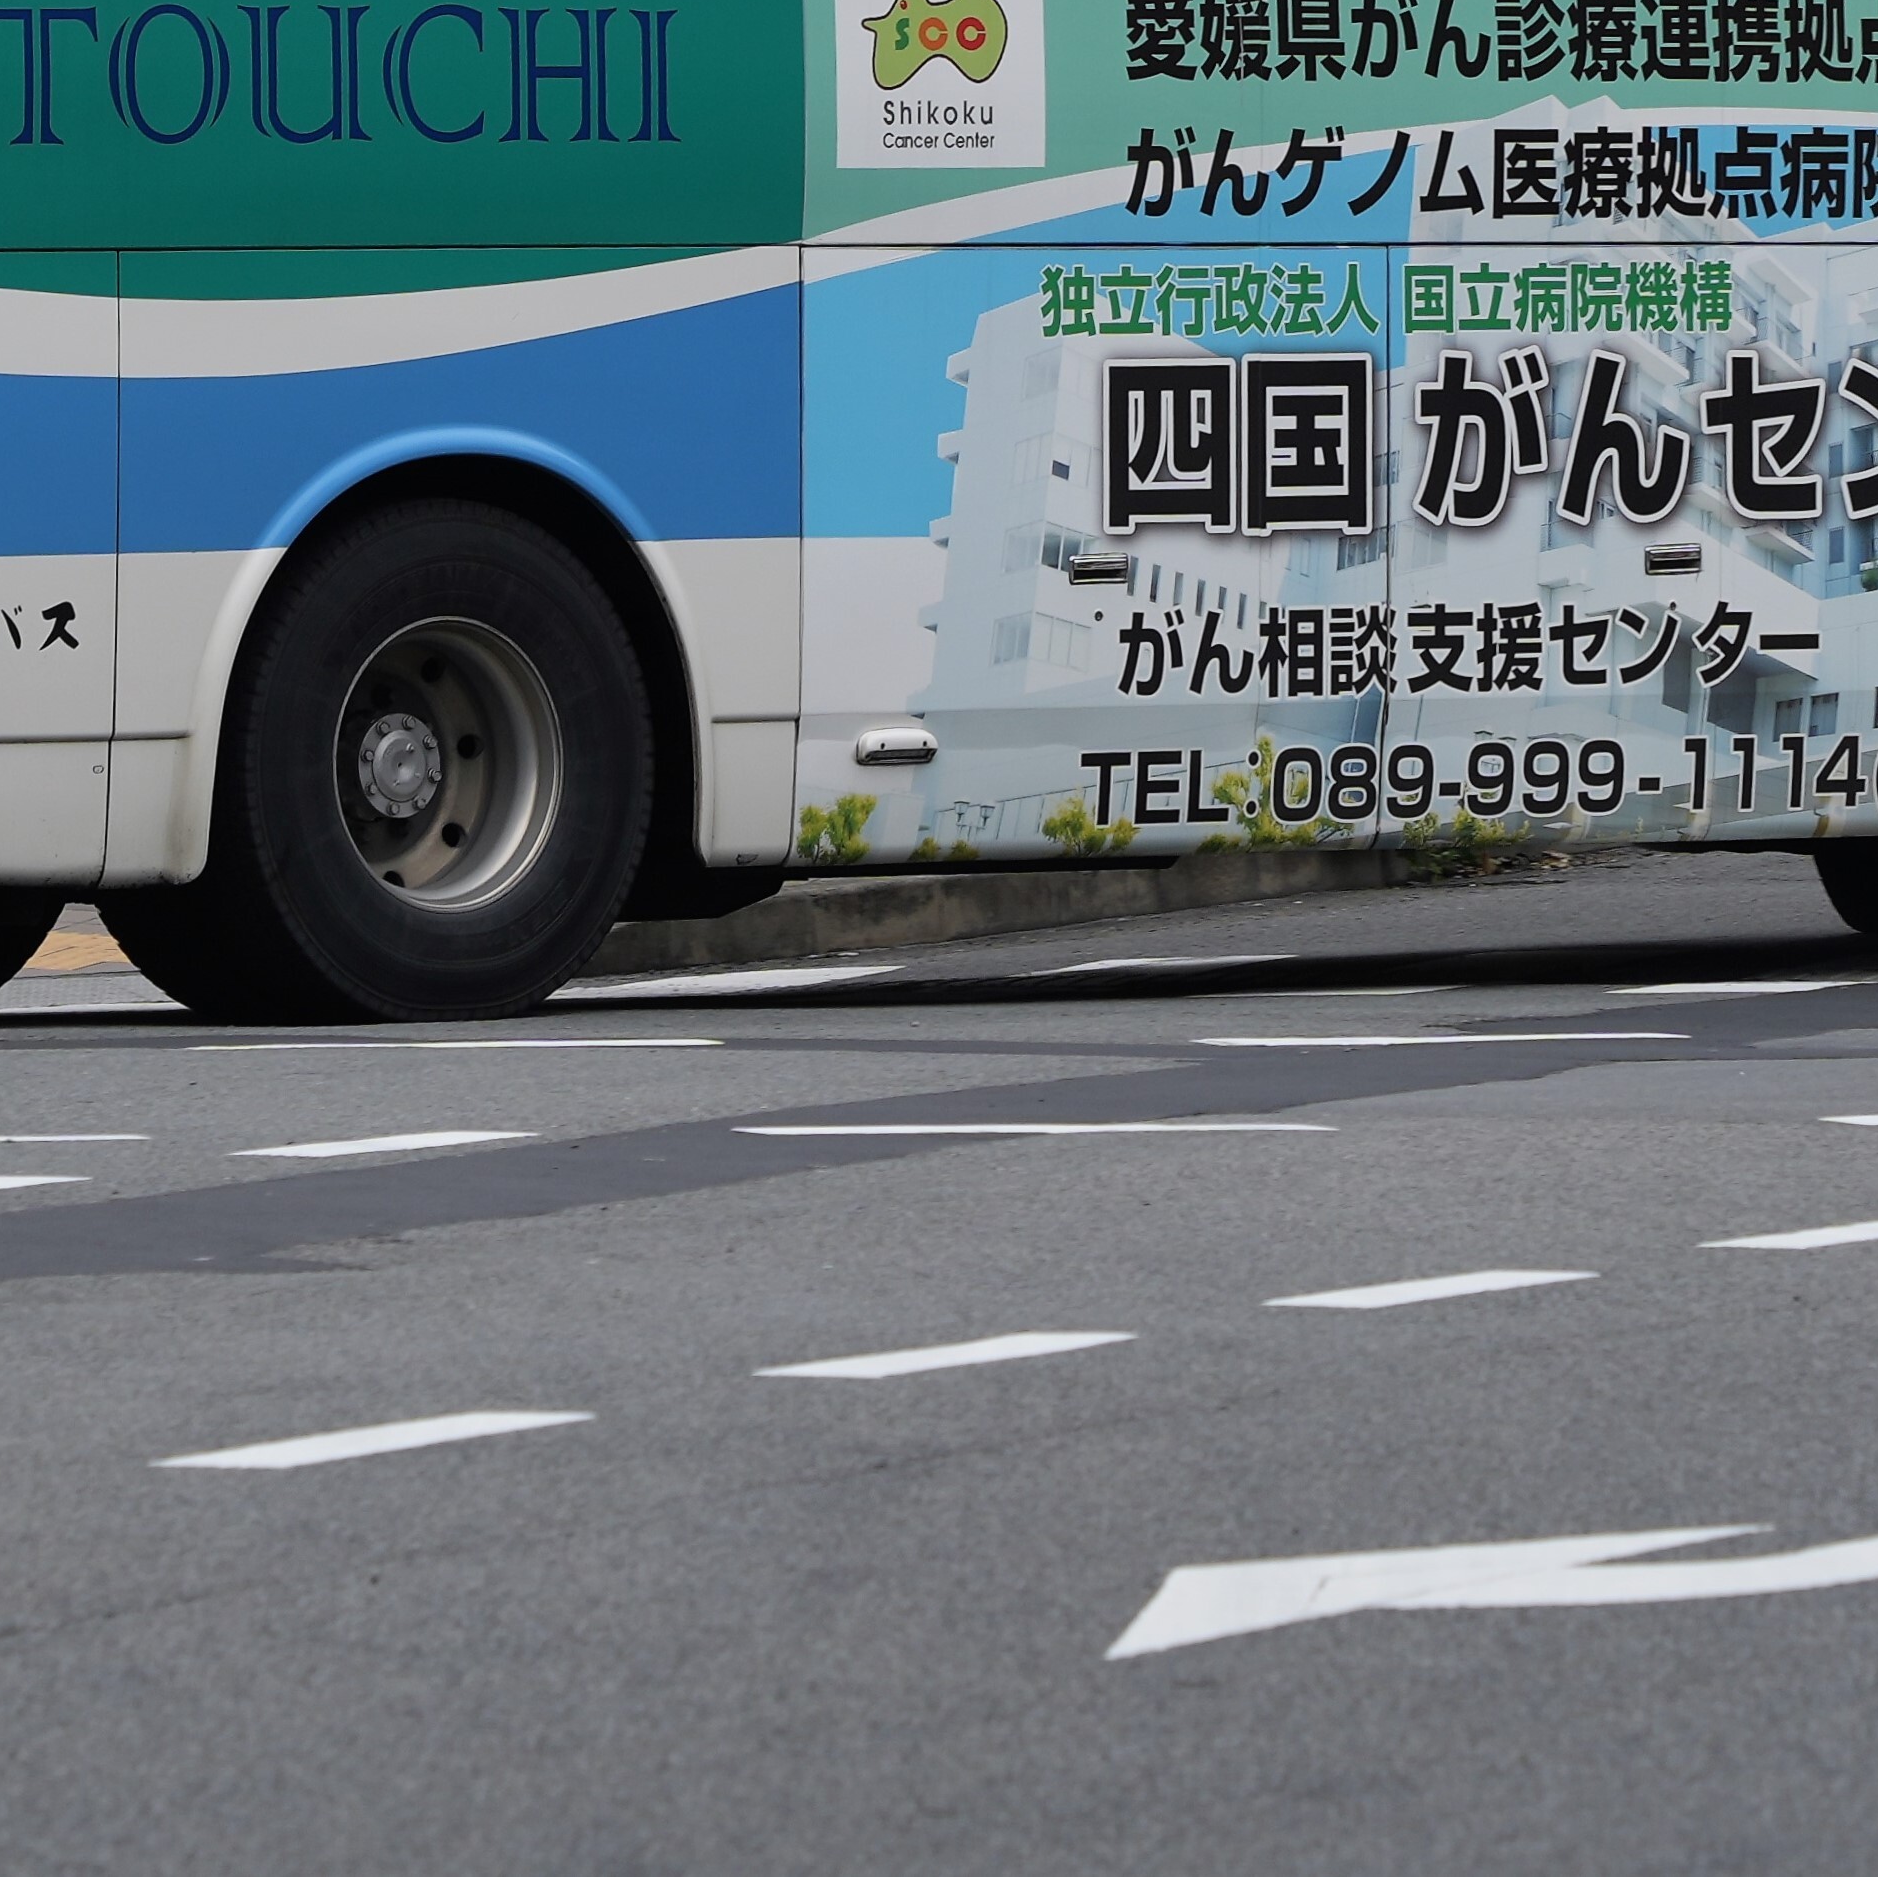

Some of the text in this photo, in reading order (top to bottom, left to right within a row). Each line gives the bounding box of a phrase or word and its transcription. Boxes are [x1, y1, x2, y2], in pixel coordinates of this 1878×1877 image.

[883, 100, 993, 125] Shikoku
[883, 130, 995, 150] Cancer Center
[1040, 259, 1732, 337] 独立行政法人 国立病院機構
[1103, 352, 1372, 535] 四国
[1117, 602, 1820, 697] がん相談支援センター
